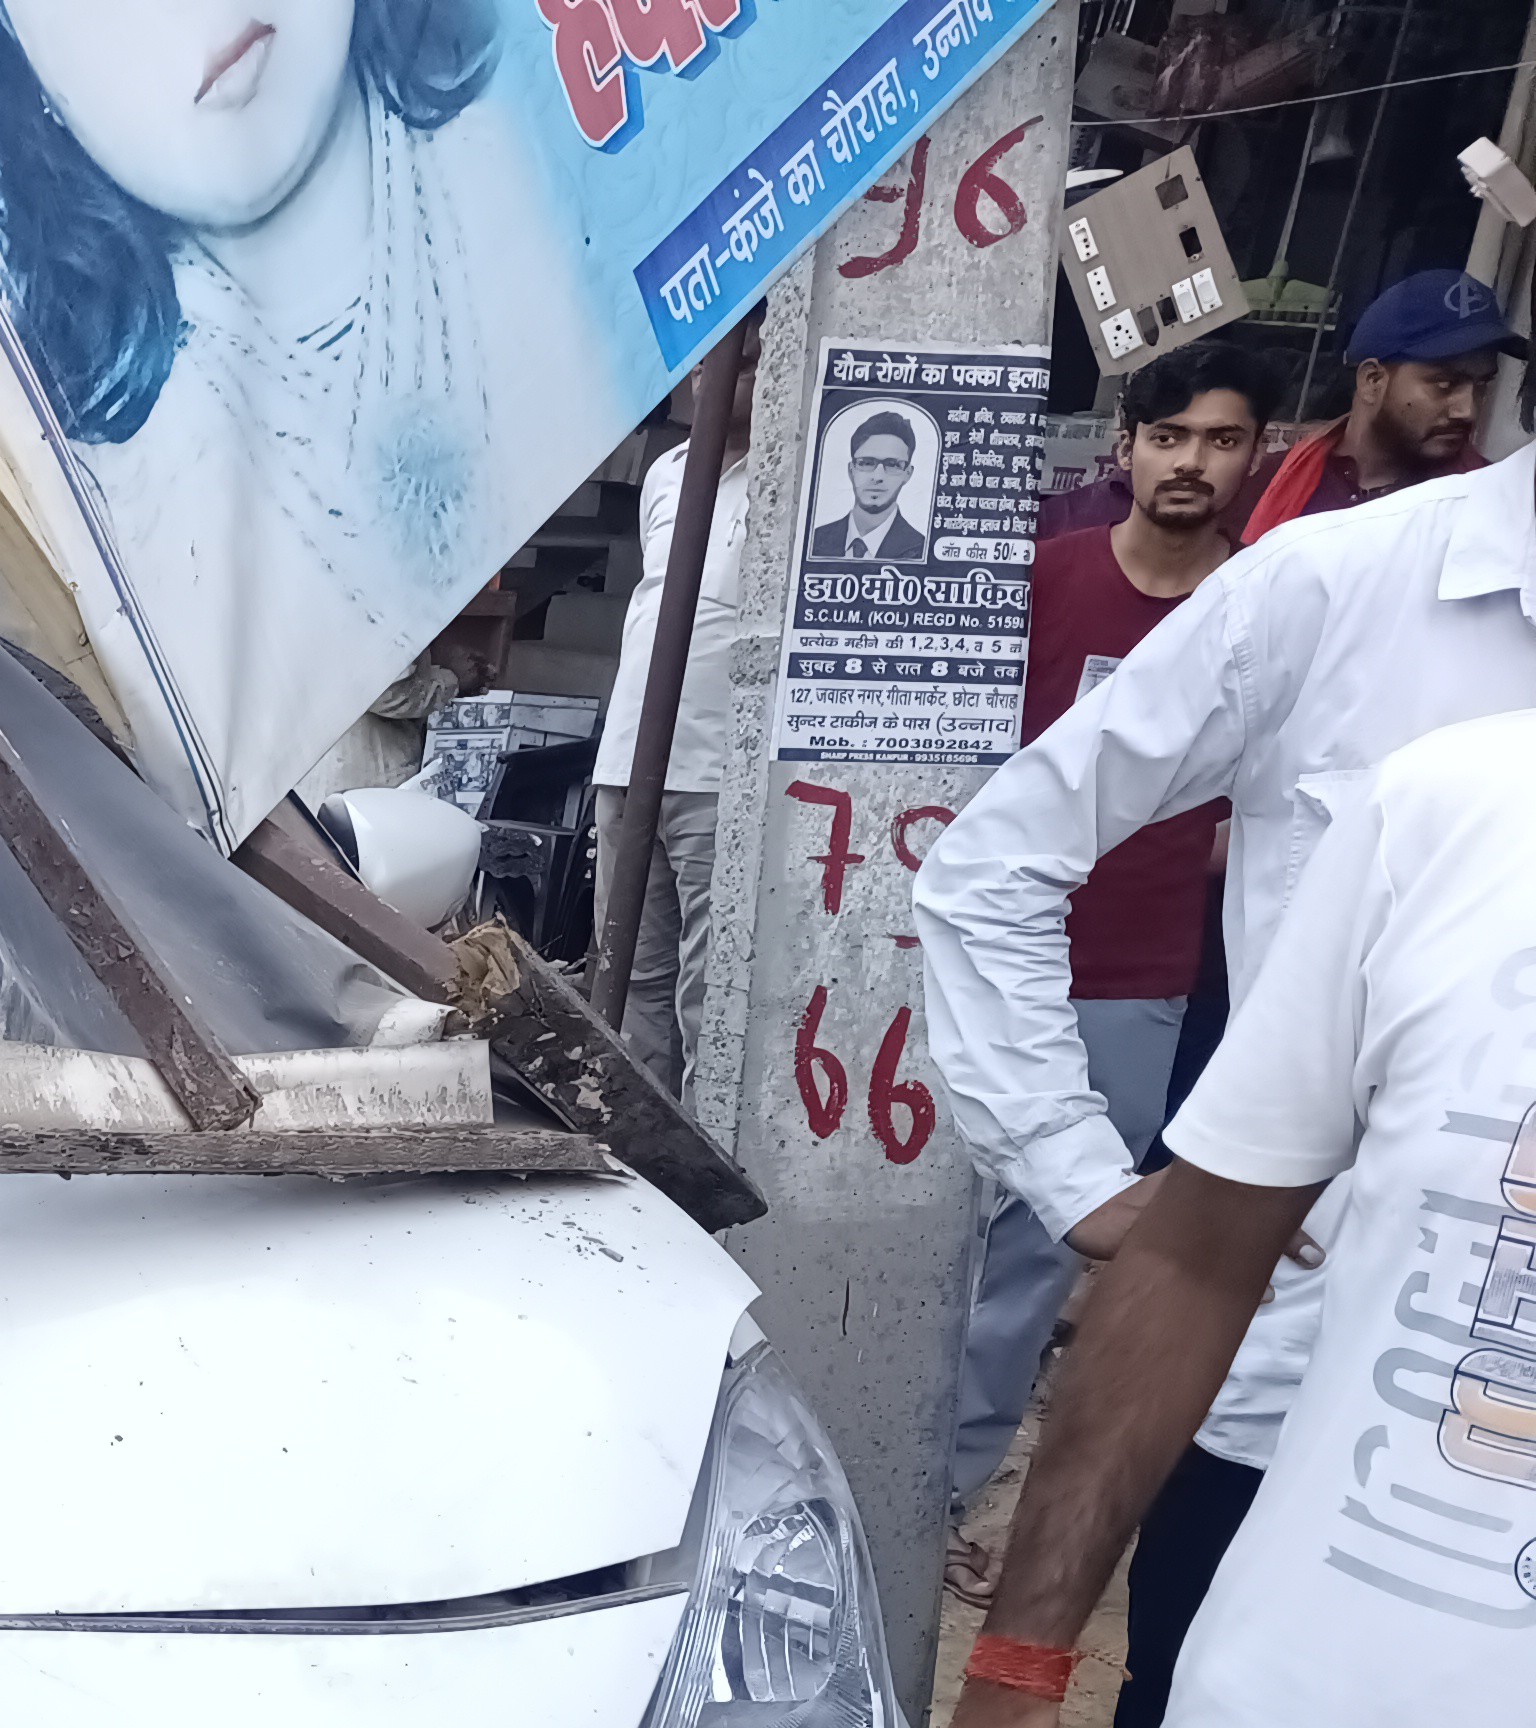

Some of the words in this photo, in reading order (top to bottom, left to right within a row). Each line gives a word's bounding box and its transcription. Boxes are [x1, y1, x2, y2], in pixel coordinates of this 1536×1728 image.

[780, 139, 826, 207] का
[820, 57, 919, 168] चौराहा,
[833, 352, 872, 382] यौन
[877, 354, 918, 384] रोगों
[921, 364, 948, 386] का
[952, 365, 1005, 388] पक्का
[868, 611, 909, 628] (KOL)
[913, 613, 956, 627] REGD
[885, 635, 904, 649] की
[991, 640, 1002, 653] 5
[798, 659, 838, 677] सुबह
[844, 658, 863, 675] 8
[871, 657, 889, 675] से
[894, 662, 924, 676] रात
[930, 660, 950, 677] 8
[957, 660, 986, 678] बजे
[993, 665, 1020, 678] तक
[816, 687, 856, 705] जवाहर
[886, 684, 912, 706] गीता
[952, 685, 981, 708] छोटा
[787, 714, 827, 733] सुन्दर
[882, 711, 900, 729] के
[903, 715, 931, 731] पास
[936, 711, 1017, 736] (उन्नाव)
[795, 985, 936, 1165] 66
